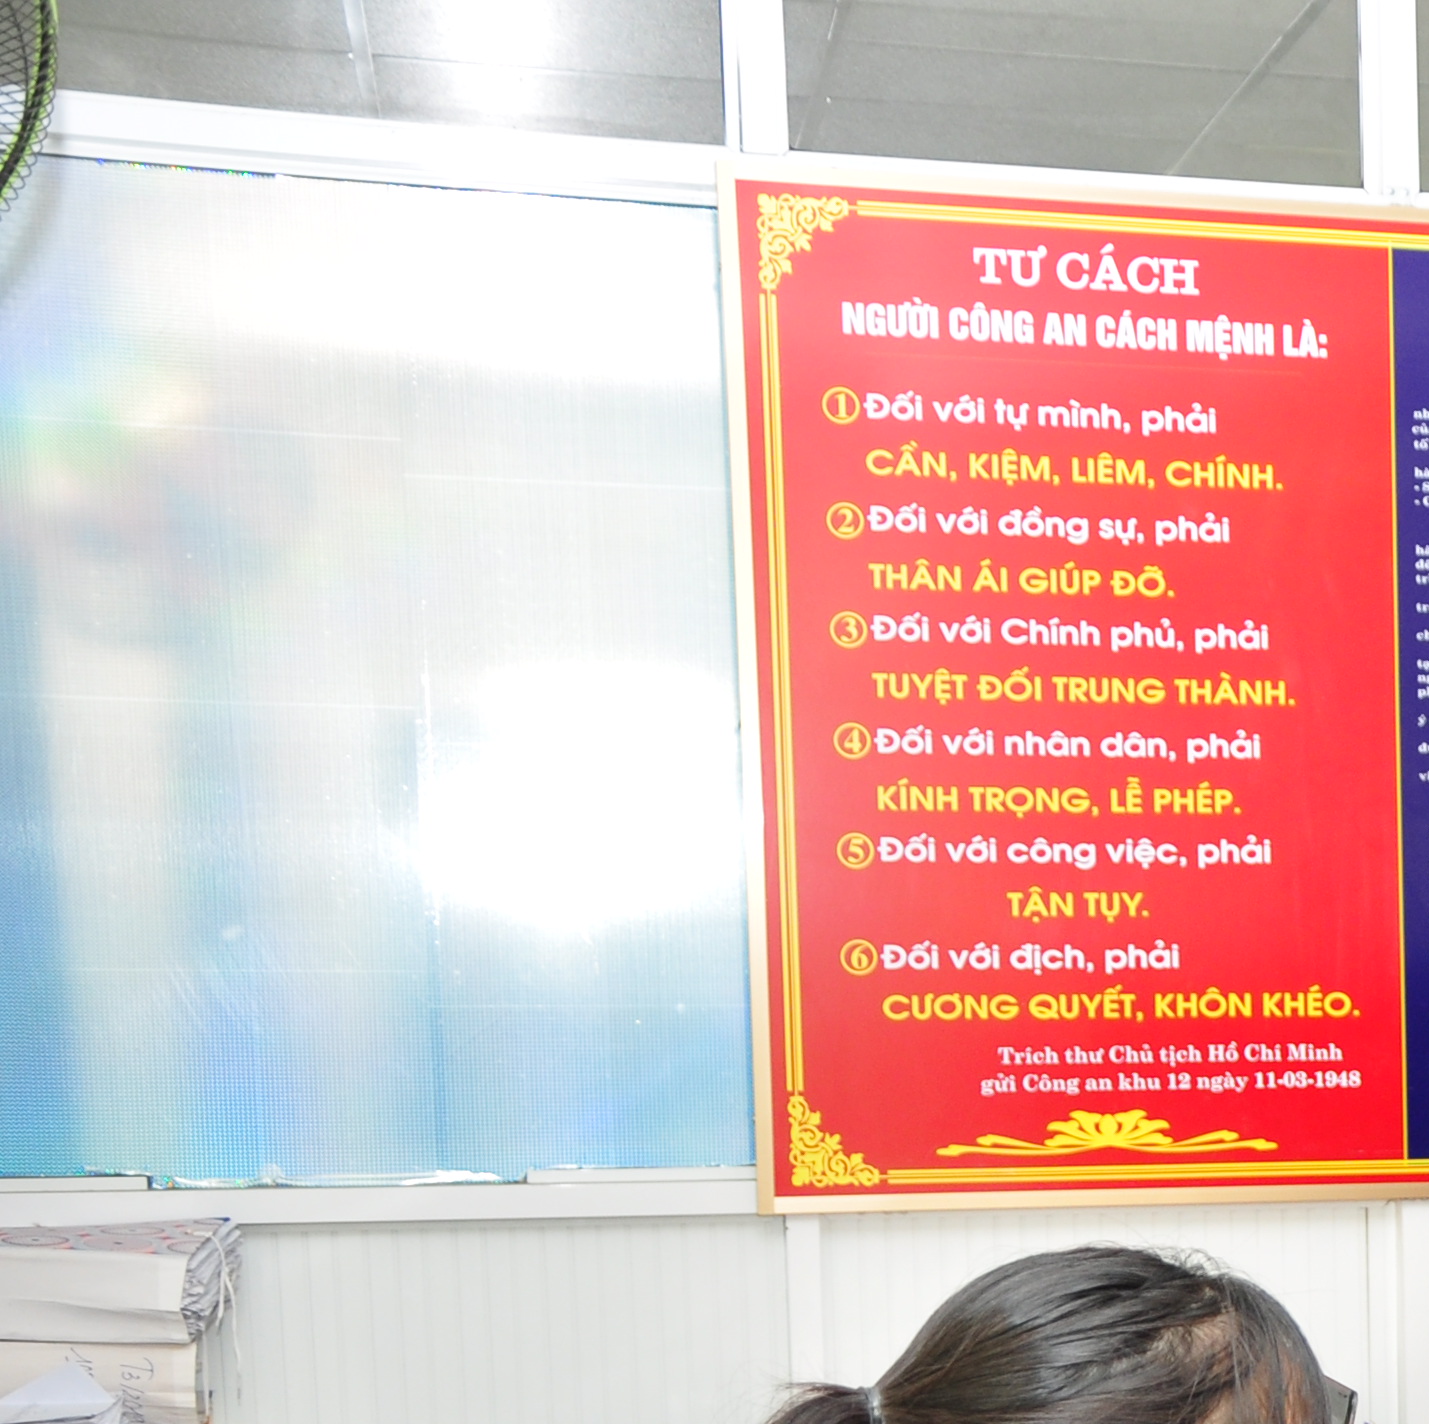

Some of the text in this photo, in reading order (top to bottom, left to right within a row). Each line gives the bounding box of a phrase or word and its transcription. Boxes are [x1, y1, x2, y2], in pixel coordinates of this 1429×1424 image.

[972, 244, 1200, 296] TƯ CÁCH
[841, 300, 1328, 359] NGƯỜI CÔNG AN CÁCH MỆNH LÀ:
[863, 391, 1217, 437] Đối với tự mình, phải
[865, 441, 1284, 490] CẦN, KIỆM, LIÊM, CHÍNH.
[866, 503, 1230, 547] Đối với đồng sự, phải
[867, 558, 1175, 598] THÂN ÁI GIÚP ĐỠ.
[870, 612, 1269, 654] Đối với Chính phủ, phải
[871, 666, 1296, 706] TUYỆT ĐỐI TRUNG THÀNH.
[873, 725, 934, 756] Đối
[941, 726, 995, 757] với
[1100, 731, 1177, 762] dân,
[1186, 728, 1261, 764] phải
[876, 776, 1241, 819] KÍNH TRỌNG, LỄ PHÉP.
[876, 832, 1272, 871] Đối với công việc, phải
[1006, 885, 1149, 924] TẬN TỤY.
[880, 939, 1180, 976] Đối với địch, phải
[882, 984, 1360, 1022] CƯƠNG QUYẾT, KHÔN KHÉO.
